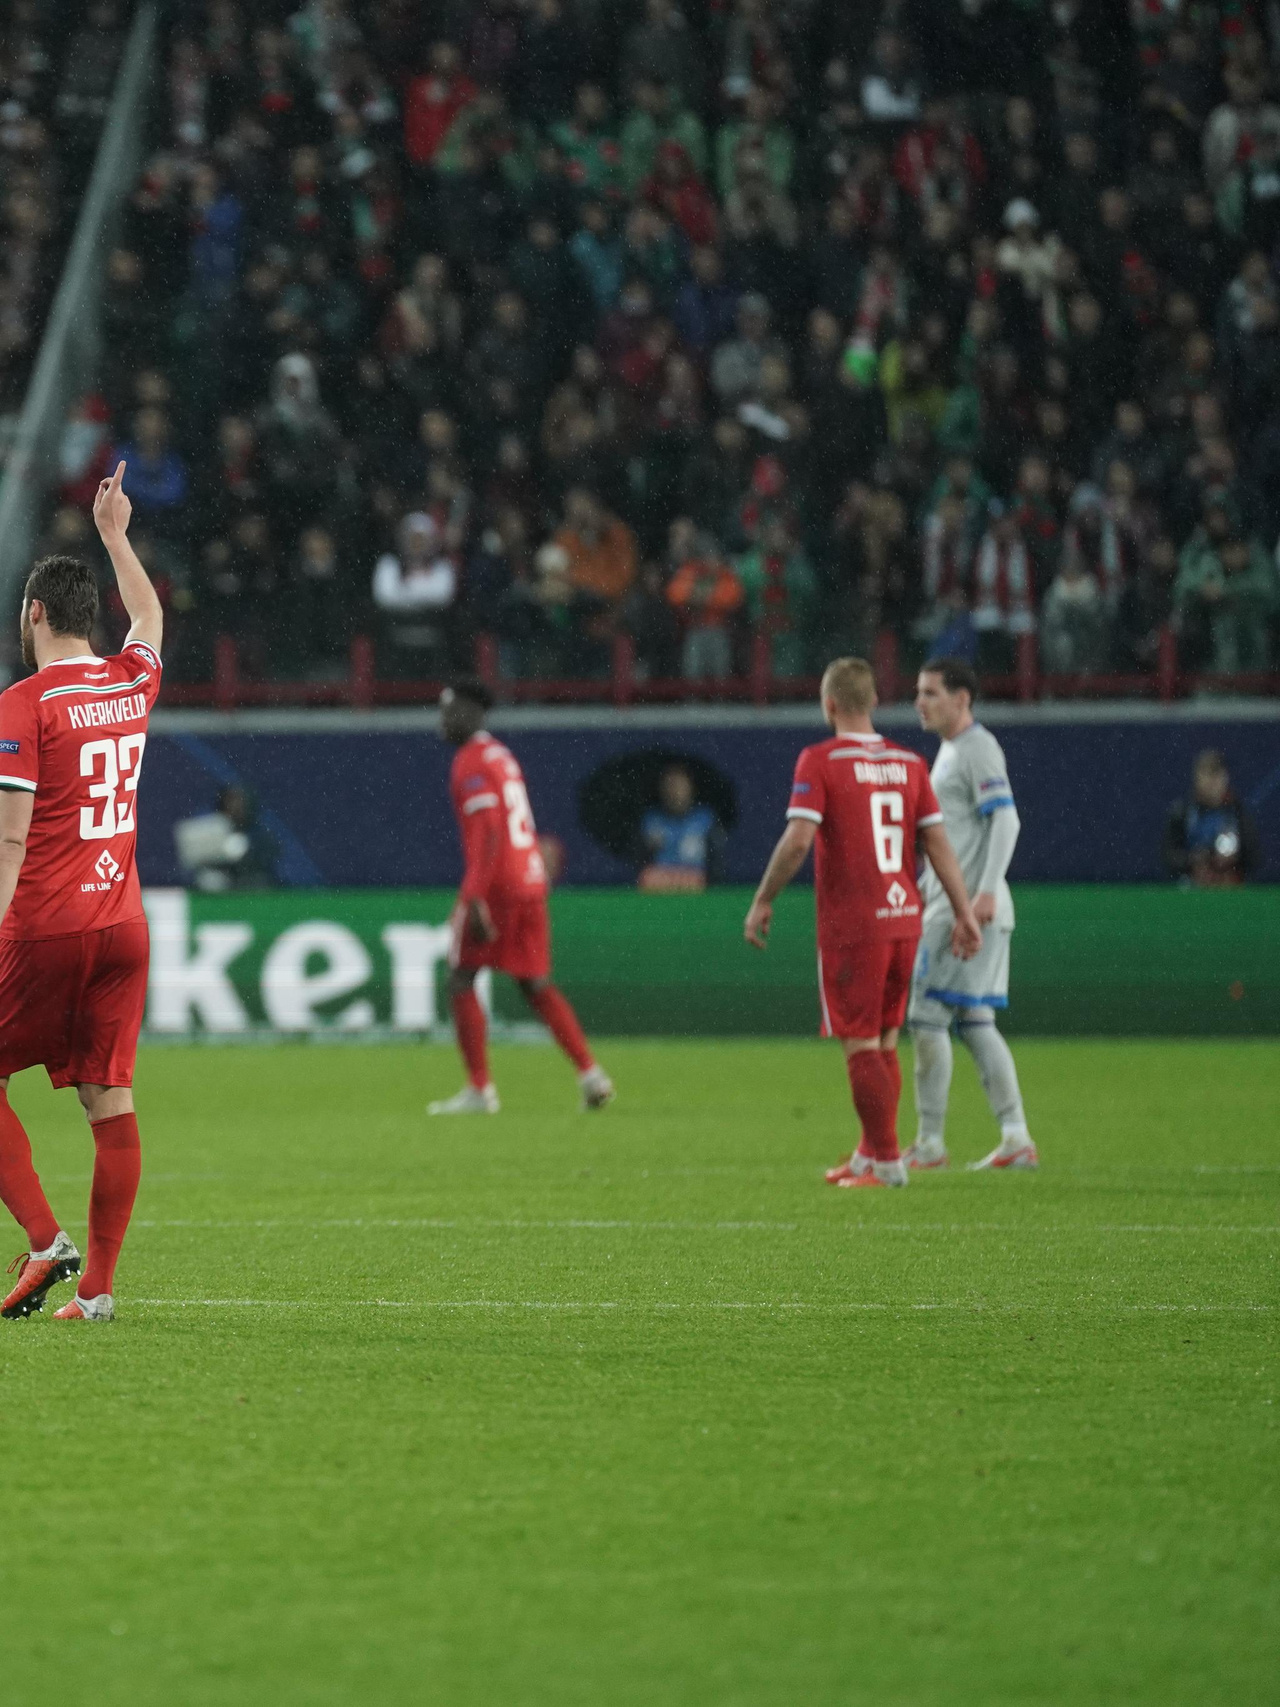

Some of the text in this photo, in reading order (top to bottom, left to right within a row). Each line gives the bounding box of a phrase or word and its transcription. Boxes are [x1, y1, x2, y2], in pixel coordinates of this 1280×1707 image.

[67, 693, 147, 730] KVERKVELIA
[80, 732, 146, 840] 33
[870, 791, 904, 874] 6
[81, 883, 96, 893] LIFE
